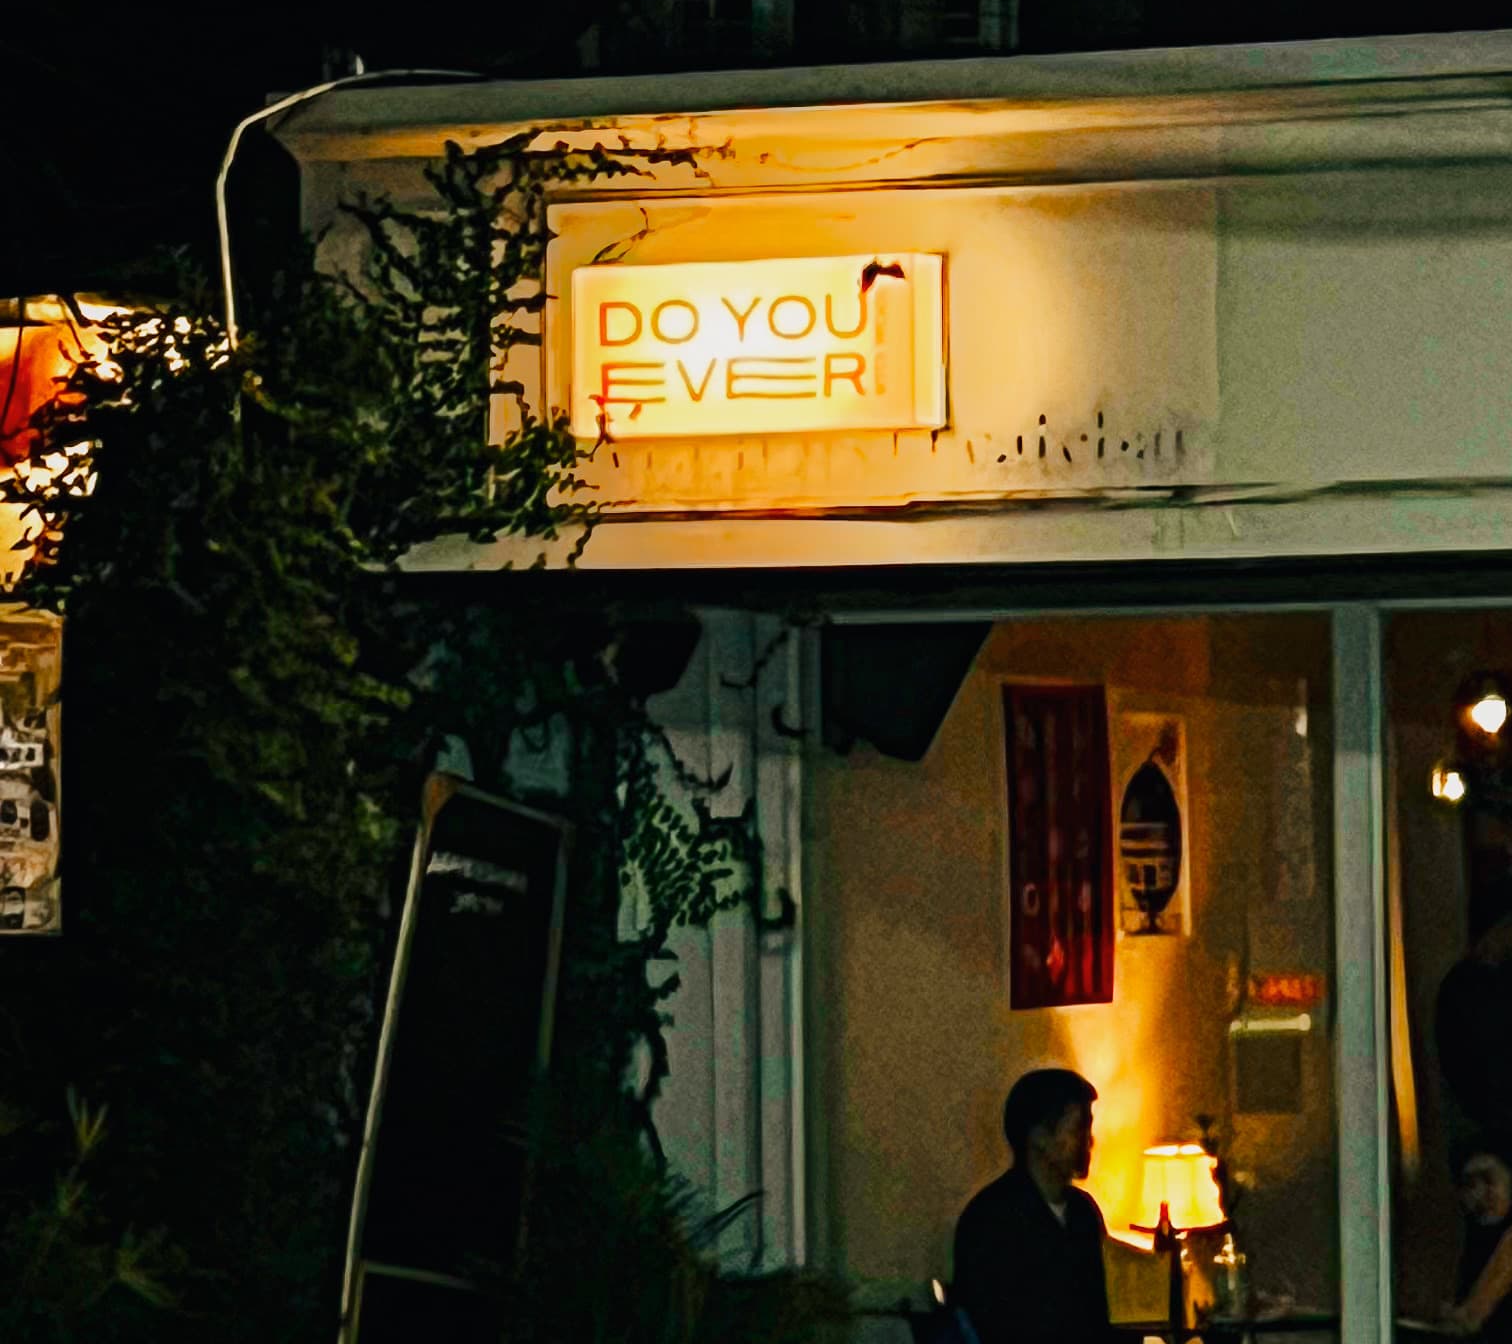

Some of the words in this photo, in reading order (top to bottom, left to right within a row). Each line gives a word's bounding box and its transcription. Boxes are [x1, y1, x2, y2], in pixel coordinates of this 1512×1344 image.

[599, 299, 699, 347] DO
[721, 292, 868, 342] YOU
[601, 351, 866, 404] EVER
